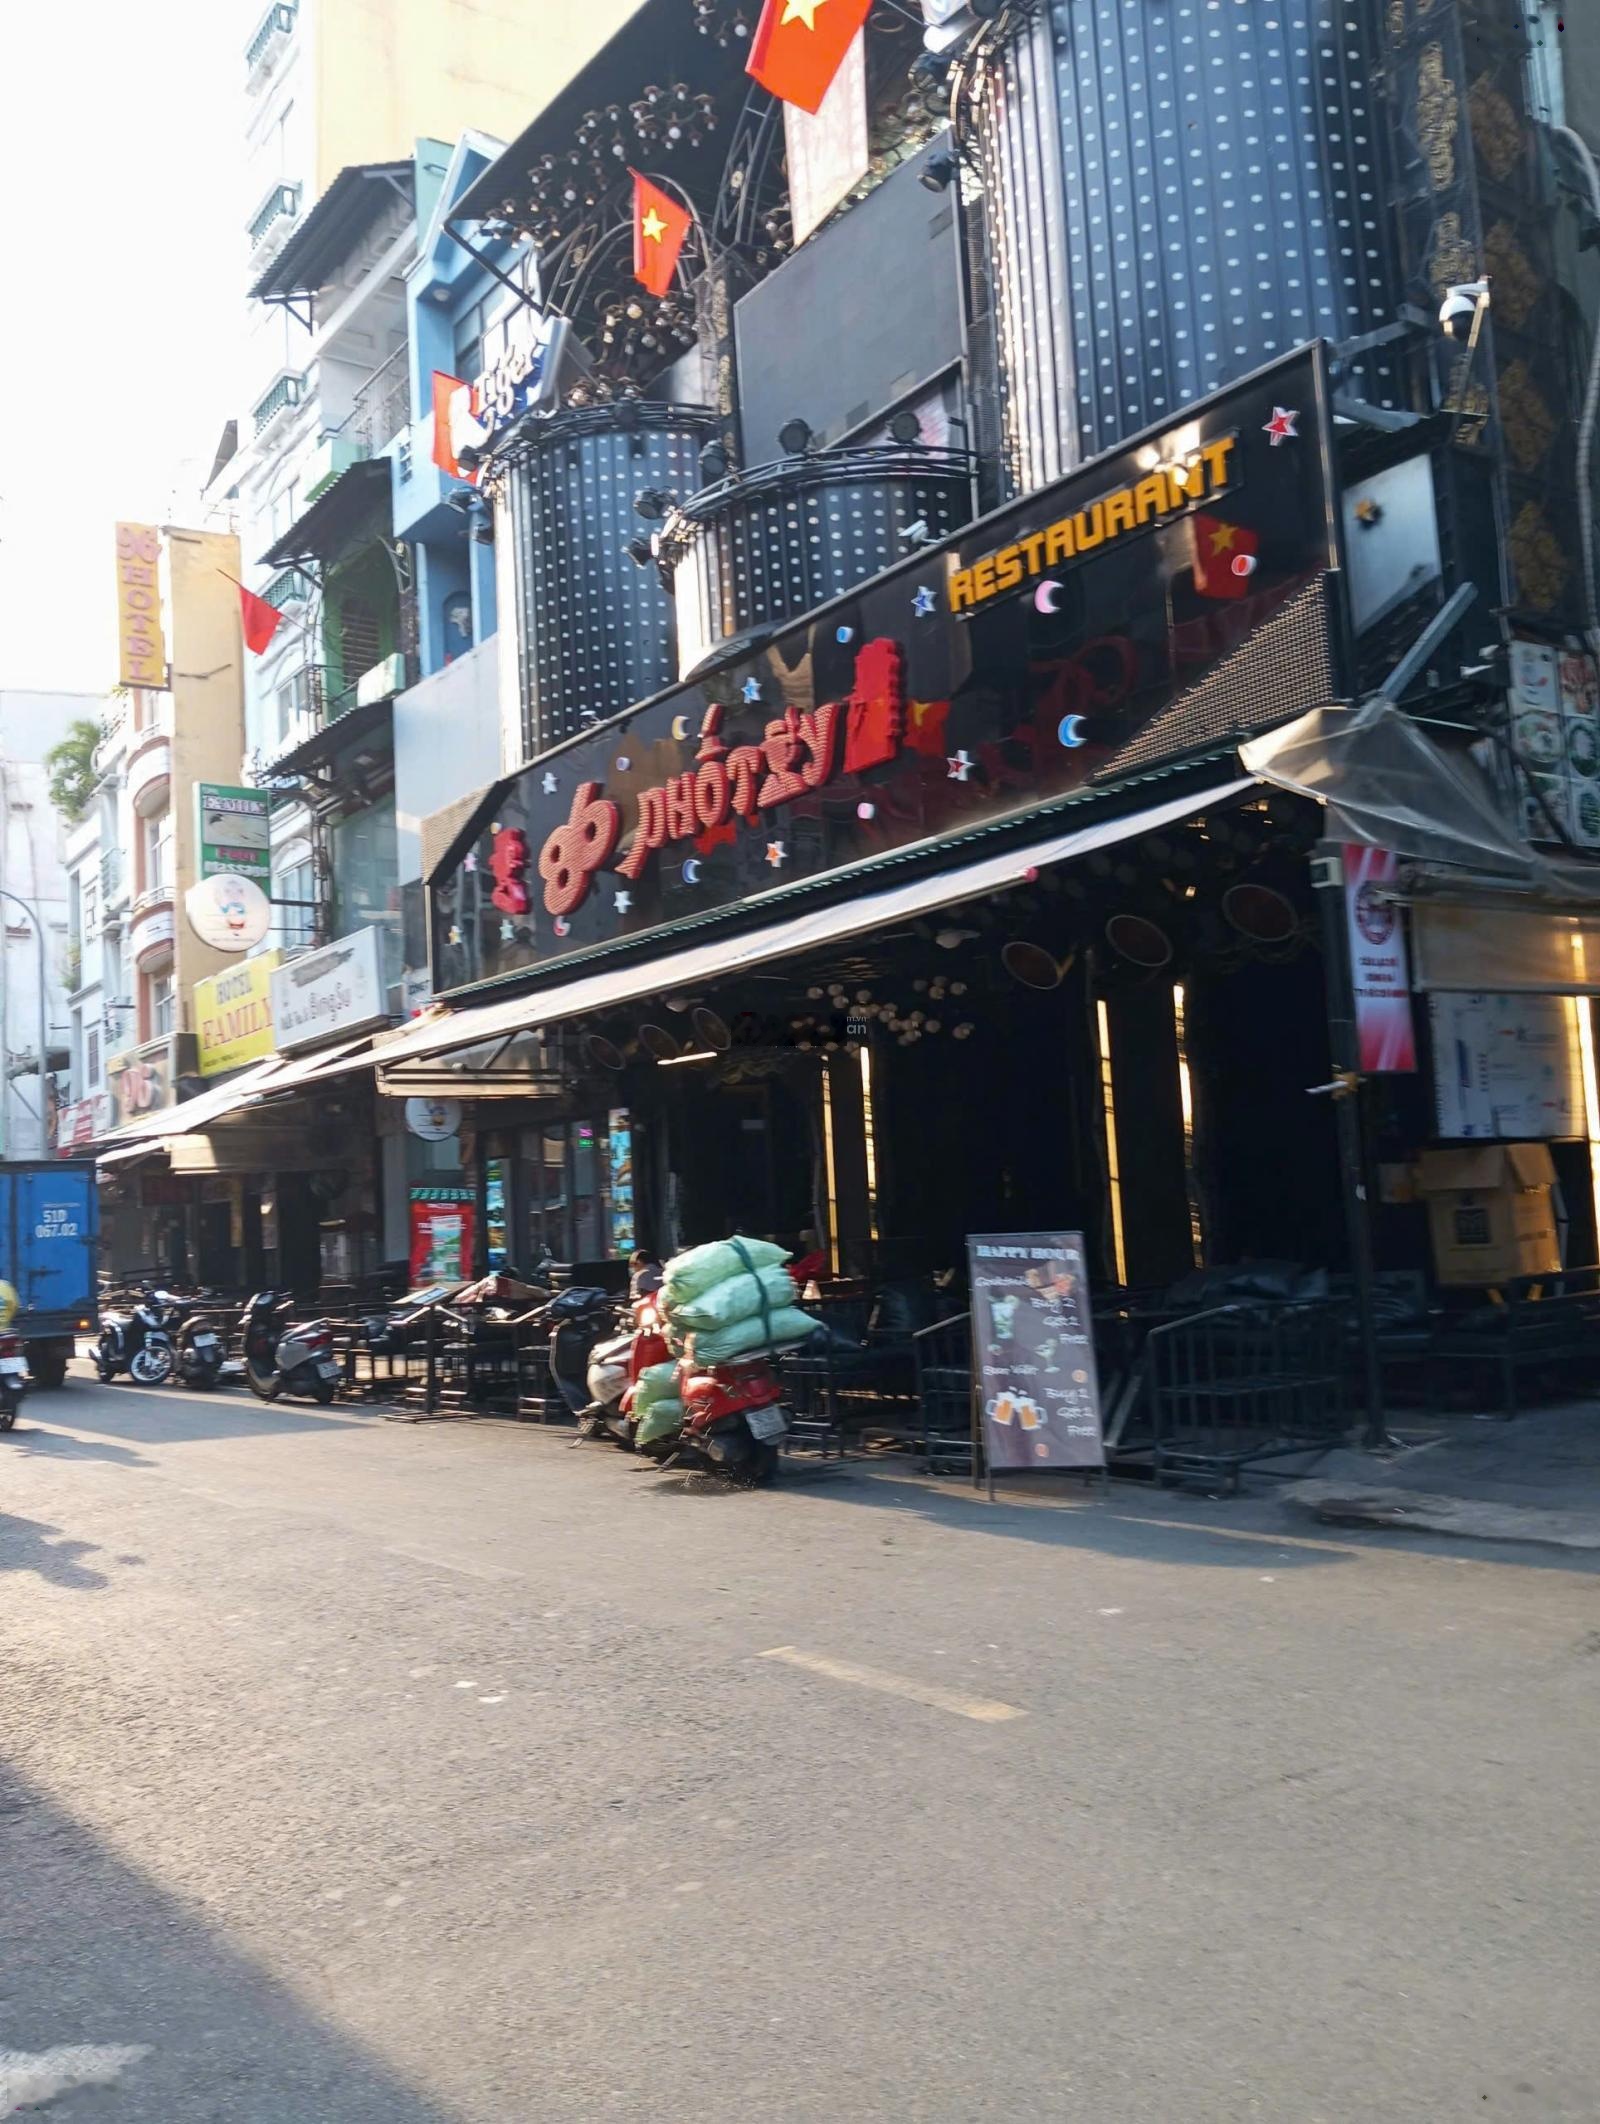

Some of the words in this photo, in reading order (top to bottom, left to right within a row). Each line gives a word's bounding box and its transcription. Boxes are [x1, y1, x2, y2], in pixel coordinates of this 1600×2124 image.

[948, 437, 1235, 614] RESTAURANT
[122, 564, 156, 680] HOTEL
[538, 781, 618, 915] 86
[202, 997, 273, 1050] FAMILY
[216, 970, 252, 1006] HOTEL
